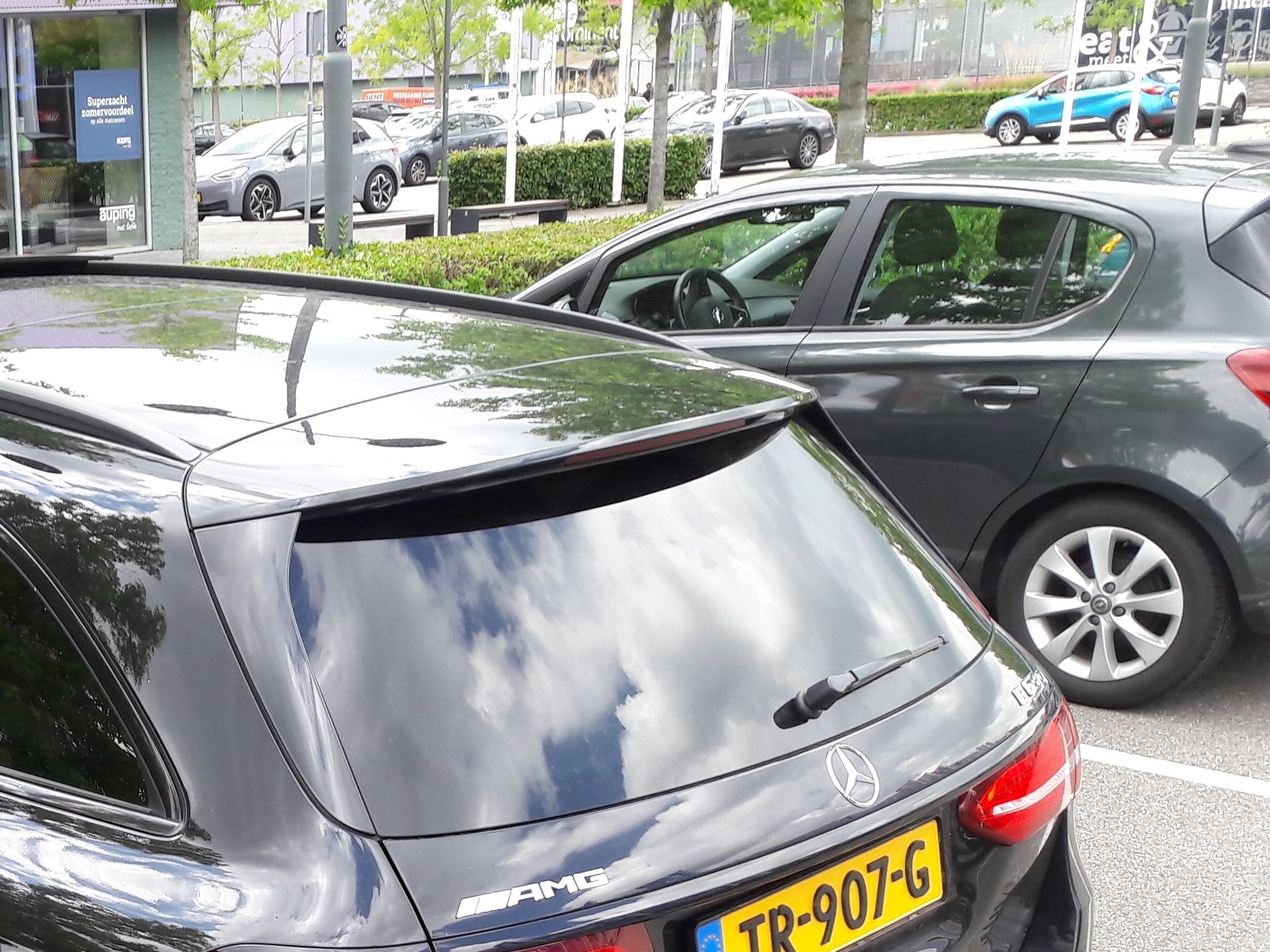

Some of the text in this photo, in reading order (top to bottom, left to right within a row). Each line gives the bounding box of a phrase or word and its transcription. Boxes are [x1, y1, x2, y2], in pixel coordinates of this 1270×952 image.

[1080, 26, 1132, 55] eat
[87, 95, 128, 108] Superzacht
[81, 105, 134, 118] zomervoordeel
[99, 206, 136, 223] auping
[507, 868, 609, 908] AMG
